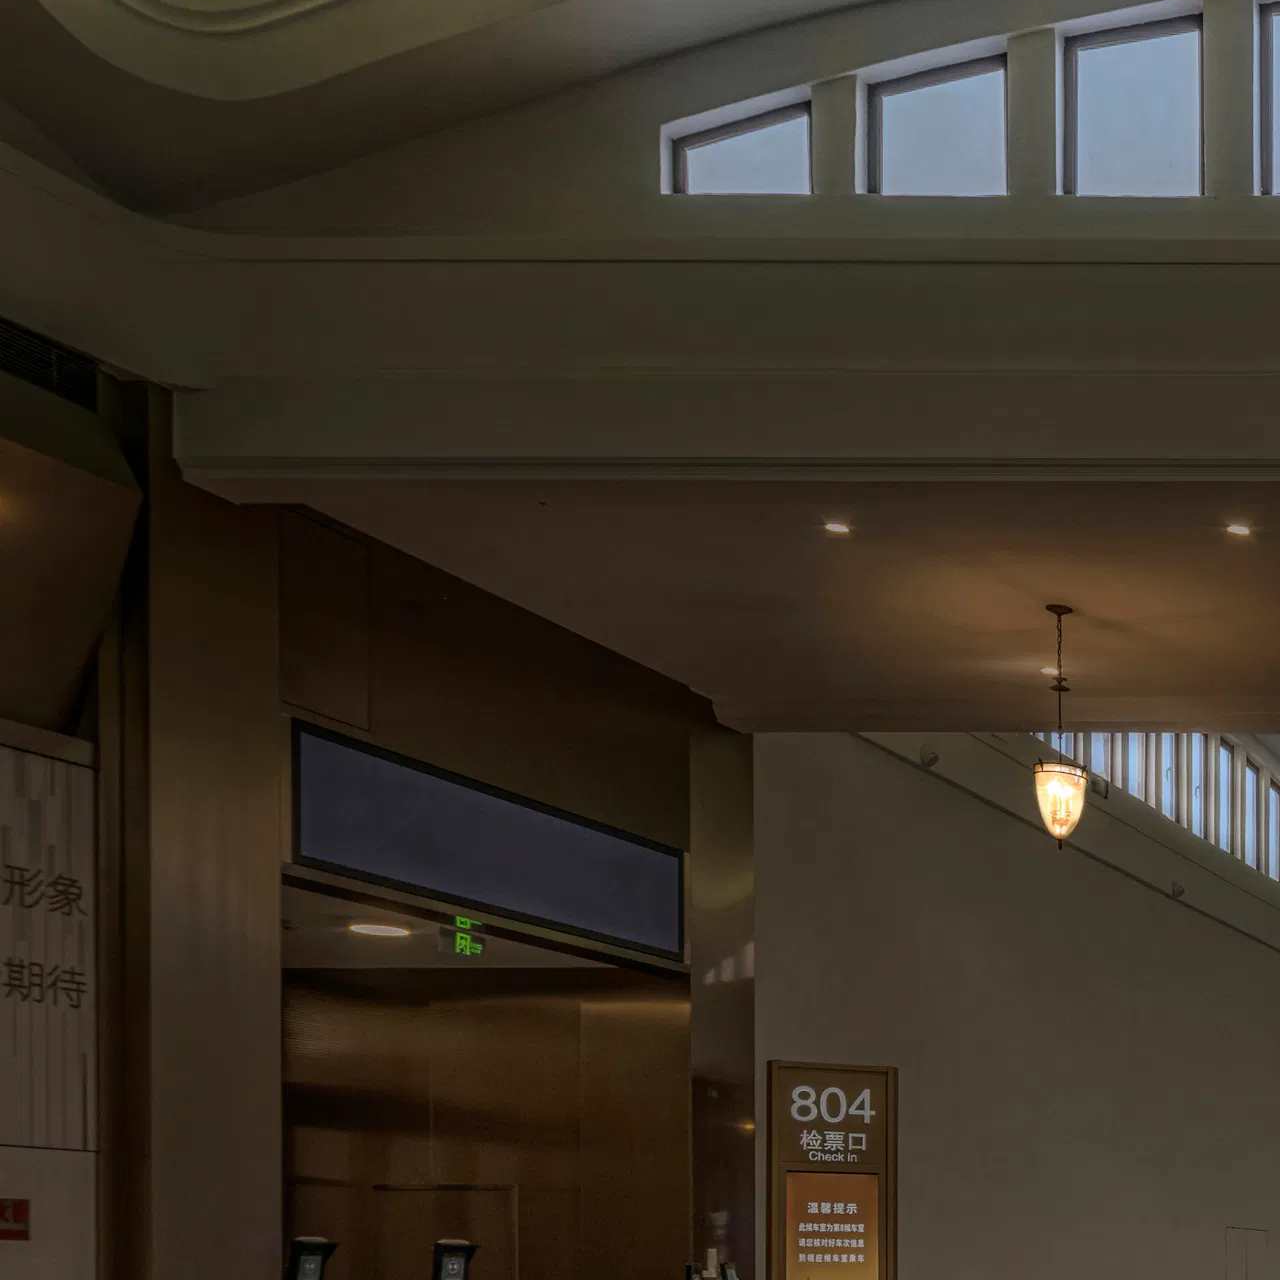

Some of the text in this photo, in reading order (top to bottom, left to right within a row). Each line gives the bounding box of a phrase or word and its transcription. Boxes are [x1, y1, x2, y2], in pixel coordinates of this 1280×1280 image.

[2, 864, 88, 917] 形象
[3, 957, 88, 1009] 期待
[790, 1085, 876, 1124] 804
[799, 1129, 867, 1151] 检票口
[808, 1151, 858, 1162] Check in
[807, 1202, 858, 1214] 温馨提示
